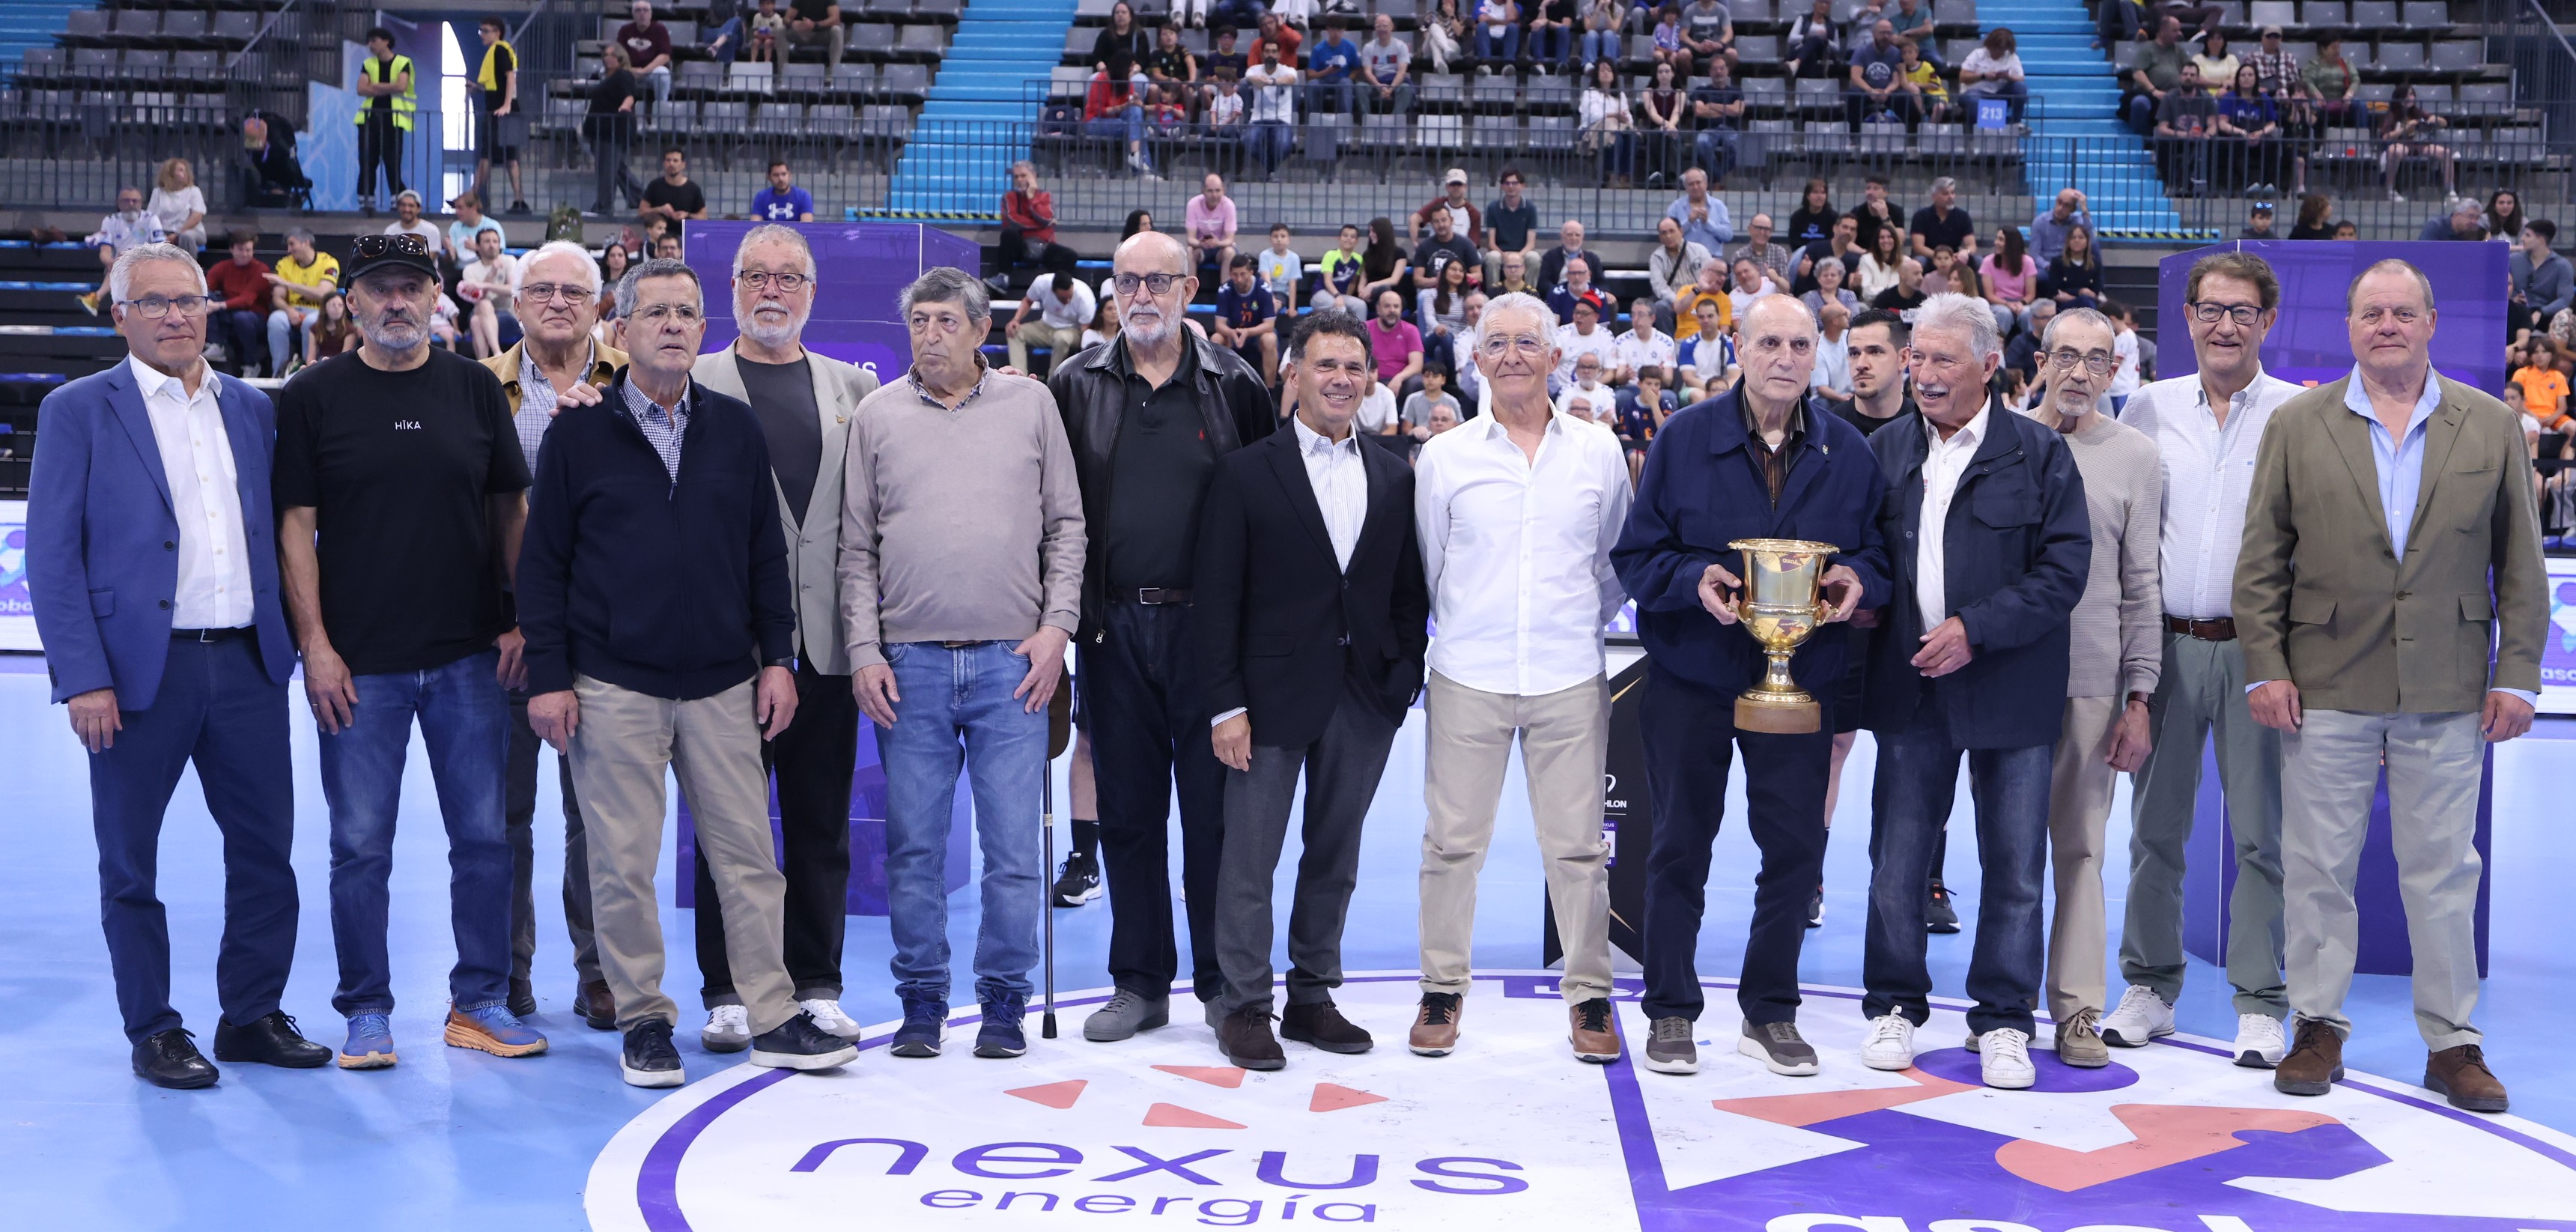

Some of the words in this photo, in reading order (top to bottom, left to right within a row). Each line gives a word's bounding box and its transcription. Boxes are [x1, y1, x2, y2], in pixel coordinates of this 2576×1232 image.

[1981, 106, 2002, 120] 213
[789, 1137, 1530, 1195] nexus
[920, 1189, 1376, 1227] energía
